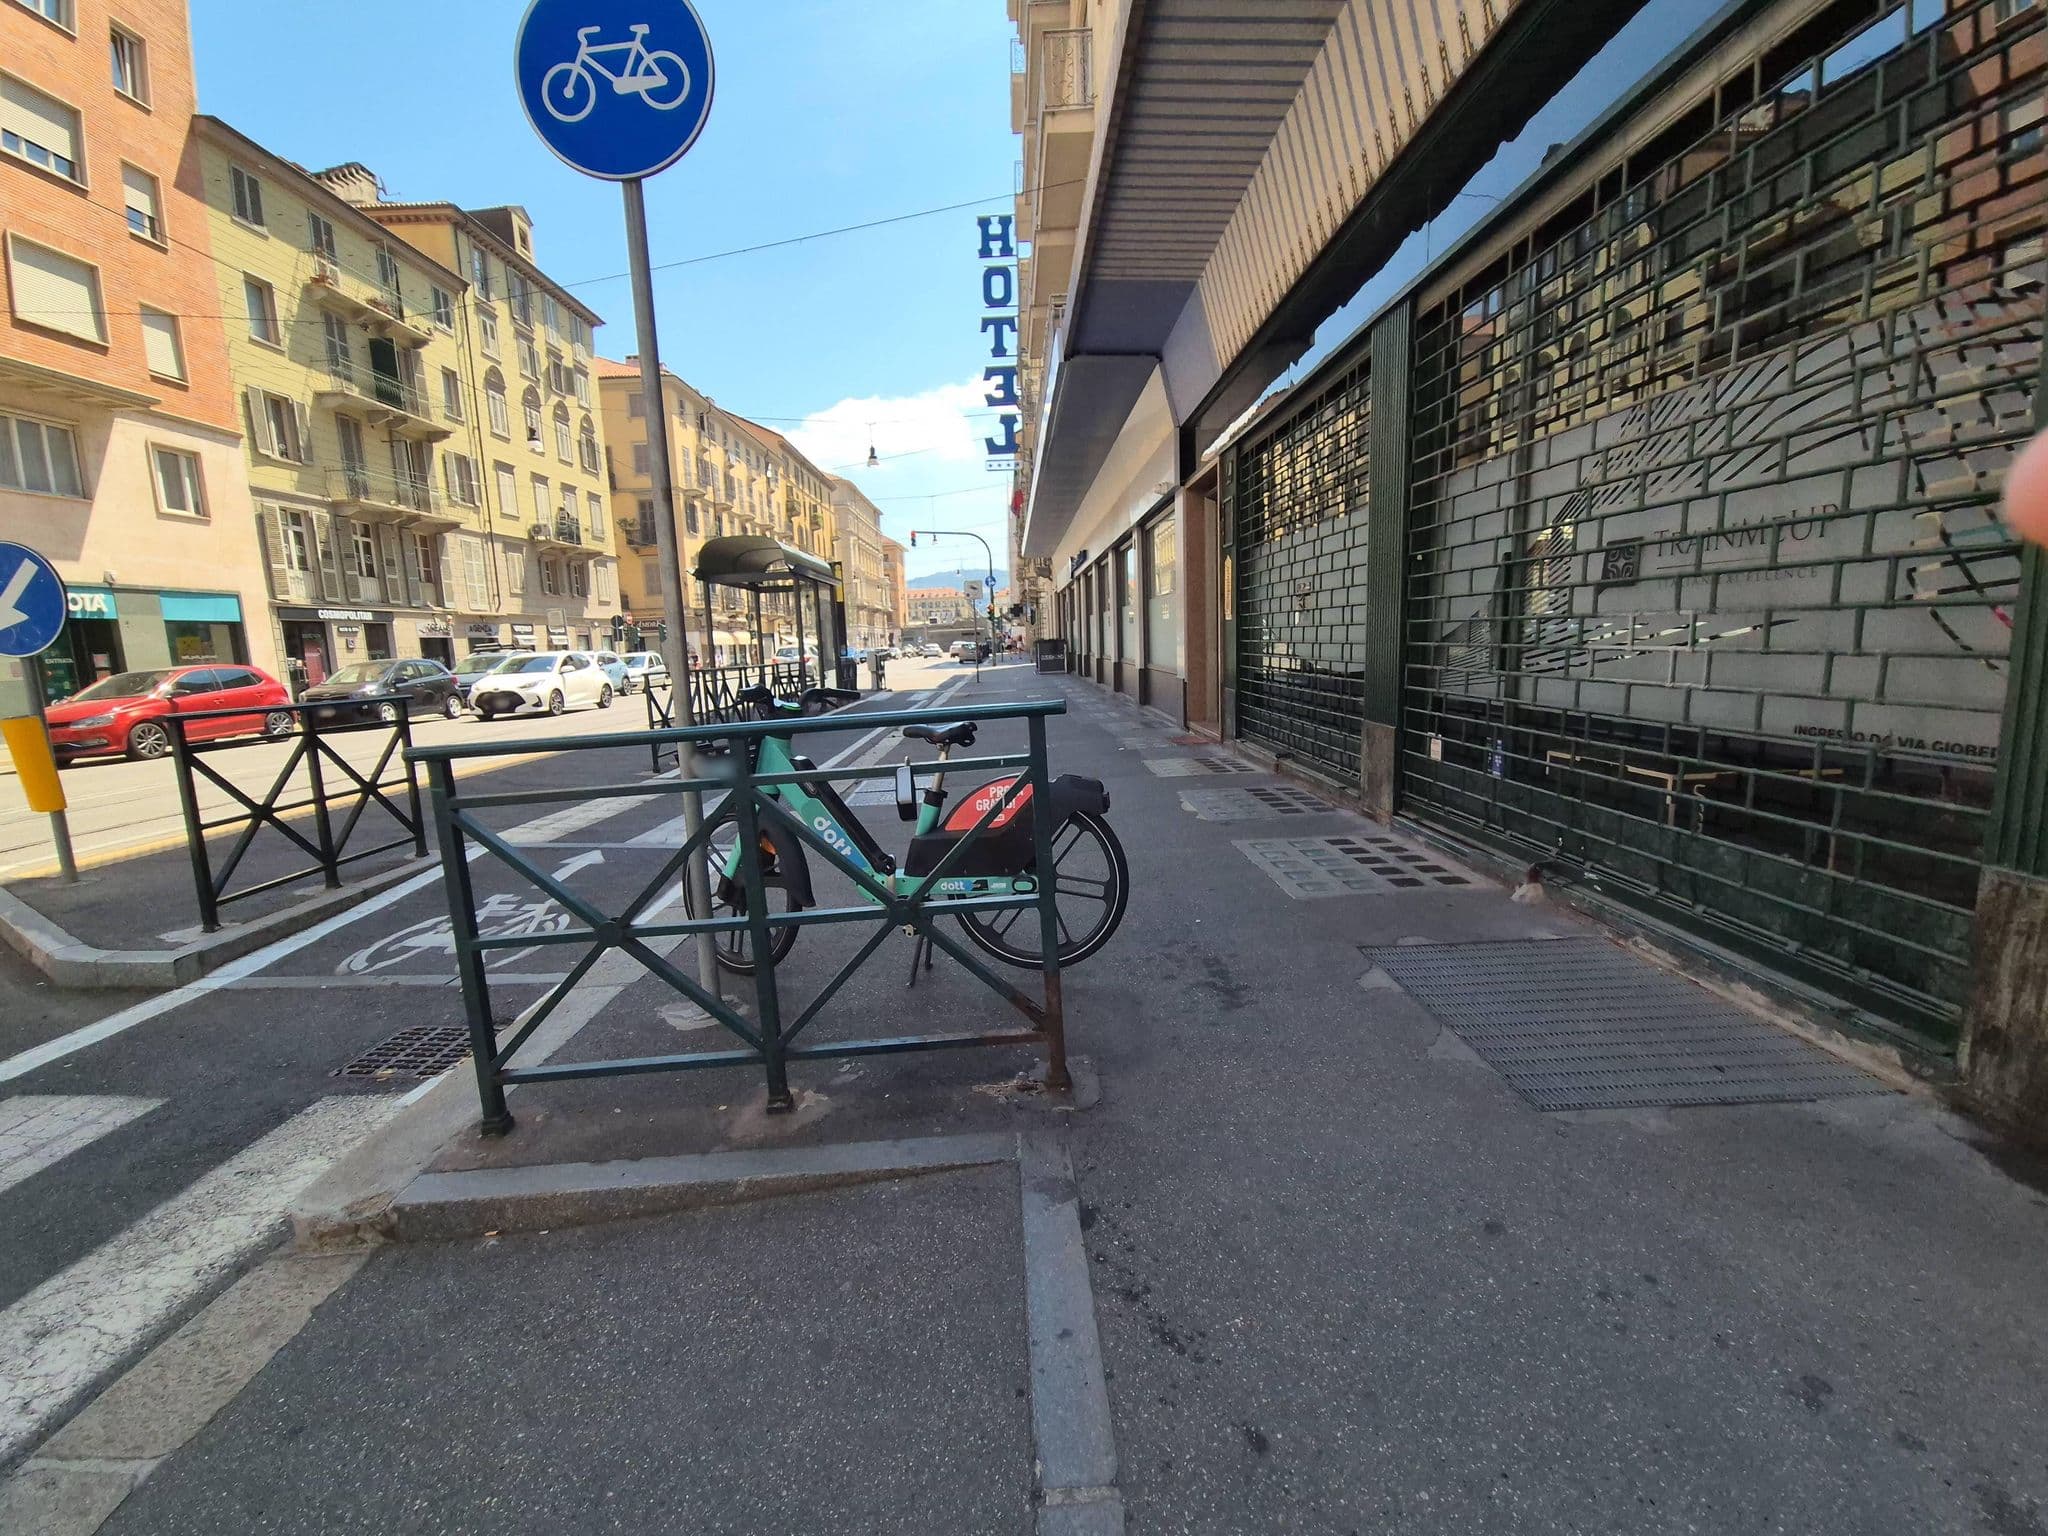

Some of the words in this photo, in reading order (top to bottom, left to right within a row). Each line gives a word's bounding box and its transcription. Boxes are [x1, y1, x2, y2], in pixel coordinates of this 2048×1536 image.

[318, 609, 373, 620] COSMOPOLITAN
[1898, 735, 1926, 750] VIA
[814, 817, 852, 856] dott
[941, 880, 965, 891] dott
